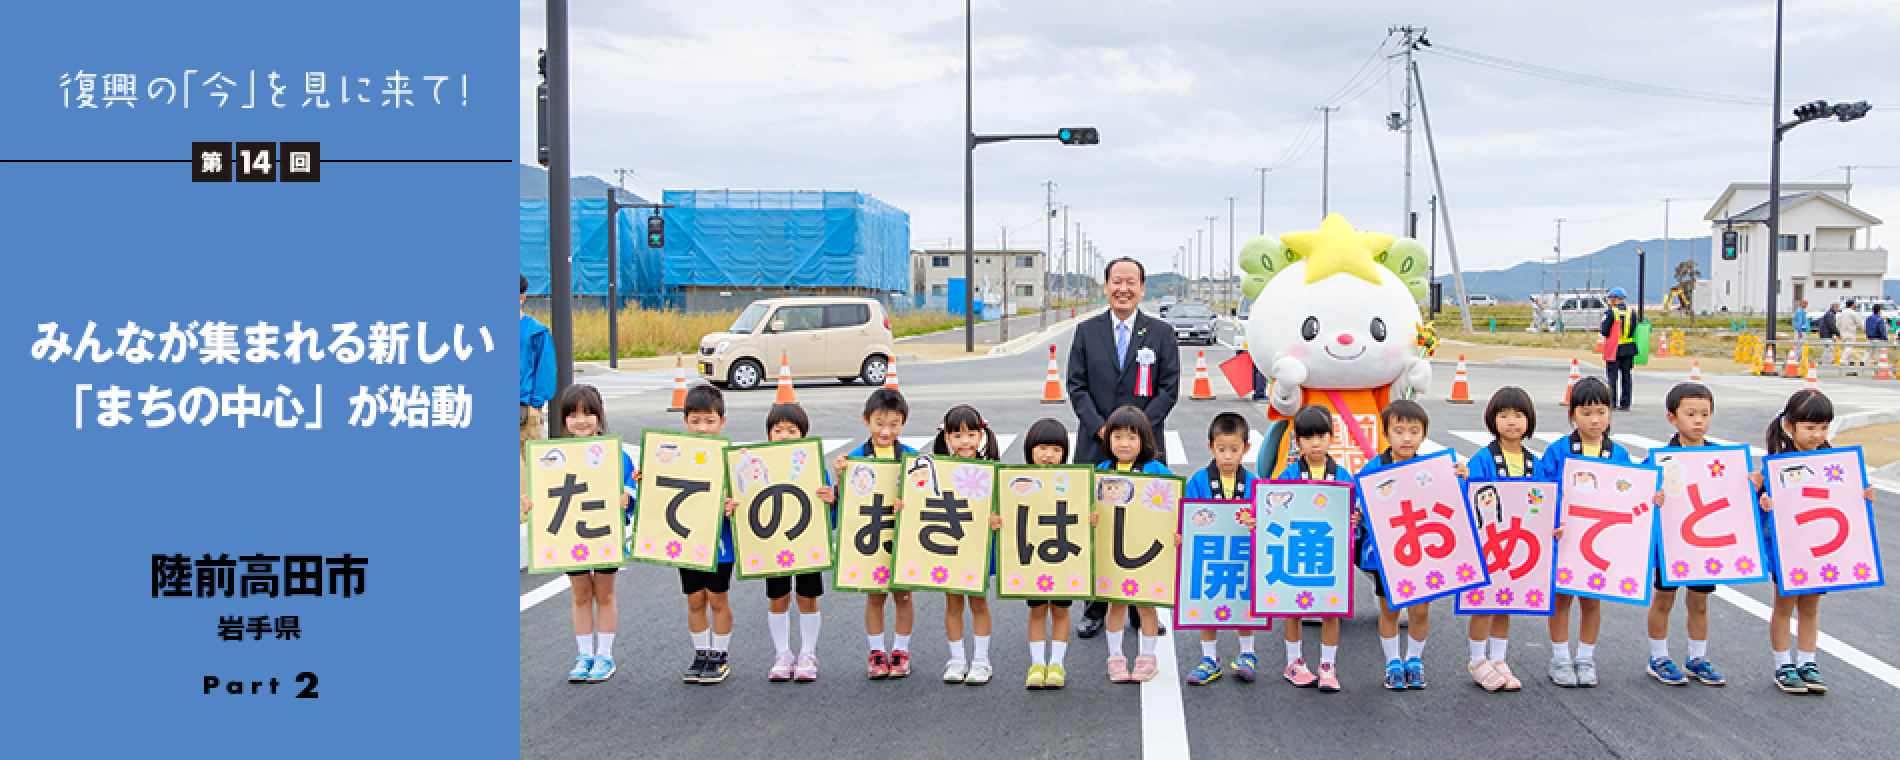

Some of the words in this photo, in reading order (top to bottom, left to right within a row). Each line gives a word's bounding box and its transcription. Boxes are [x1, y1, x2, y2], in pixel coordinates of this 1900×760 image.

[548, 474, 611, 539] た
[656, 475, 711, 539] て
[748, 483, 812, 541] の
[918, 491, 973, 555] き
[1016, 500, 1082, 565] は
[1113, 505, 1164, 569] し
[1389, 499, 1457, 567] お
[1567, 502, 1649, 571] で
[1681, 483, 1737, 547] と
[1795, 487, 1849, 557] う
[1265, 521, 1337, 588] 通
[1483, 515, 1541, 581] め
